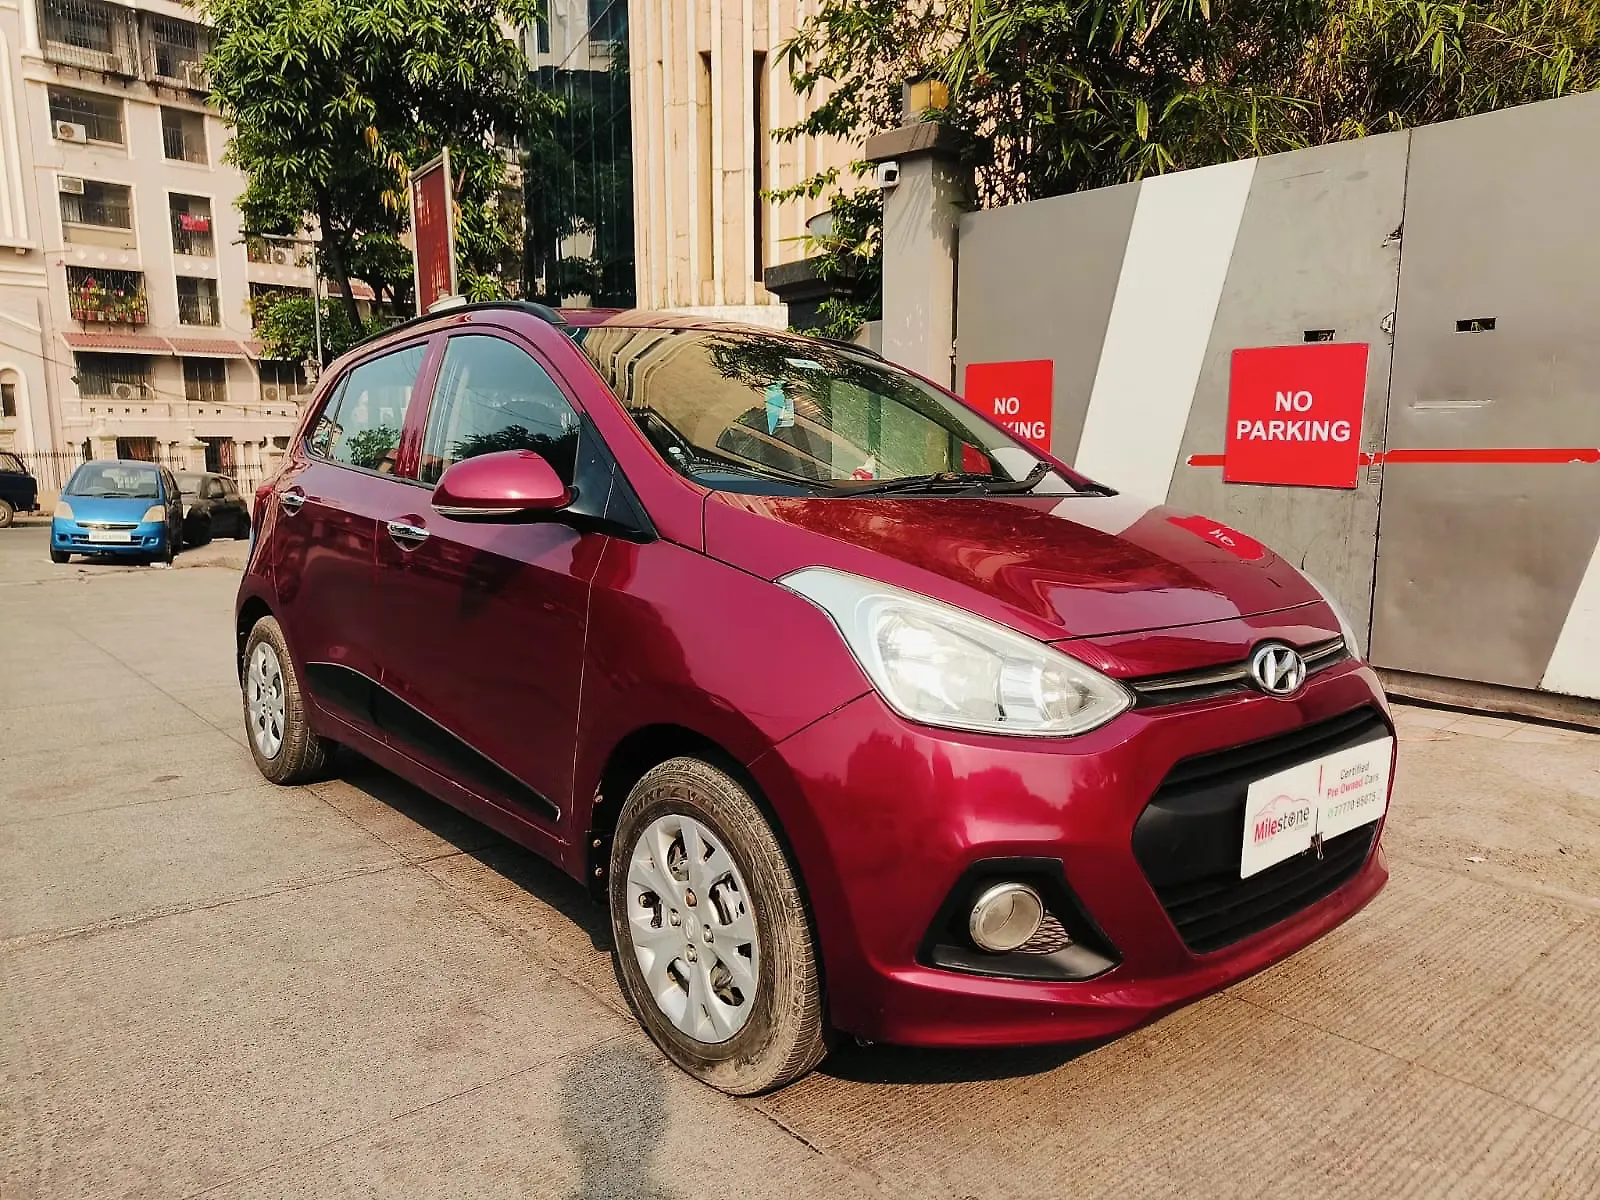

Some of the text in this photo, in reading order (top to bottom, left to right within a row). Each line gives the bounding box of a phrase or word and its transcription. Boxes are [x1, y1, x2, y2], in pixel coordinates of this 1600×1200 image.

[994, 397, 1020, 415] NO
[1275, 391, 1313, 412] NO
[1236, 420, 1351, 442] PARKING
[1340, 761, 1370, 780] Certified
[1340, 778, 1363, 794] Owned
[1254, 807, 1310, 843] Milestone
